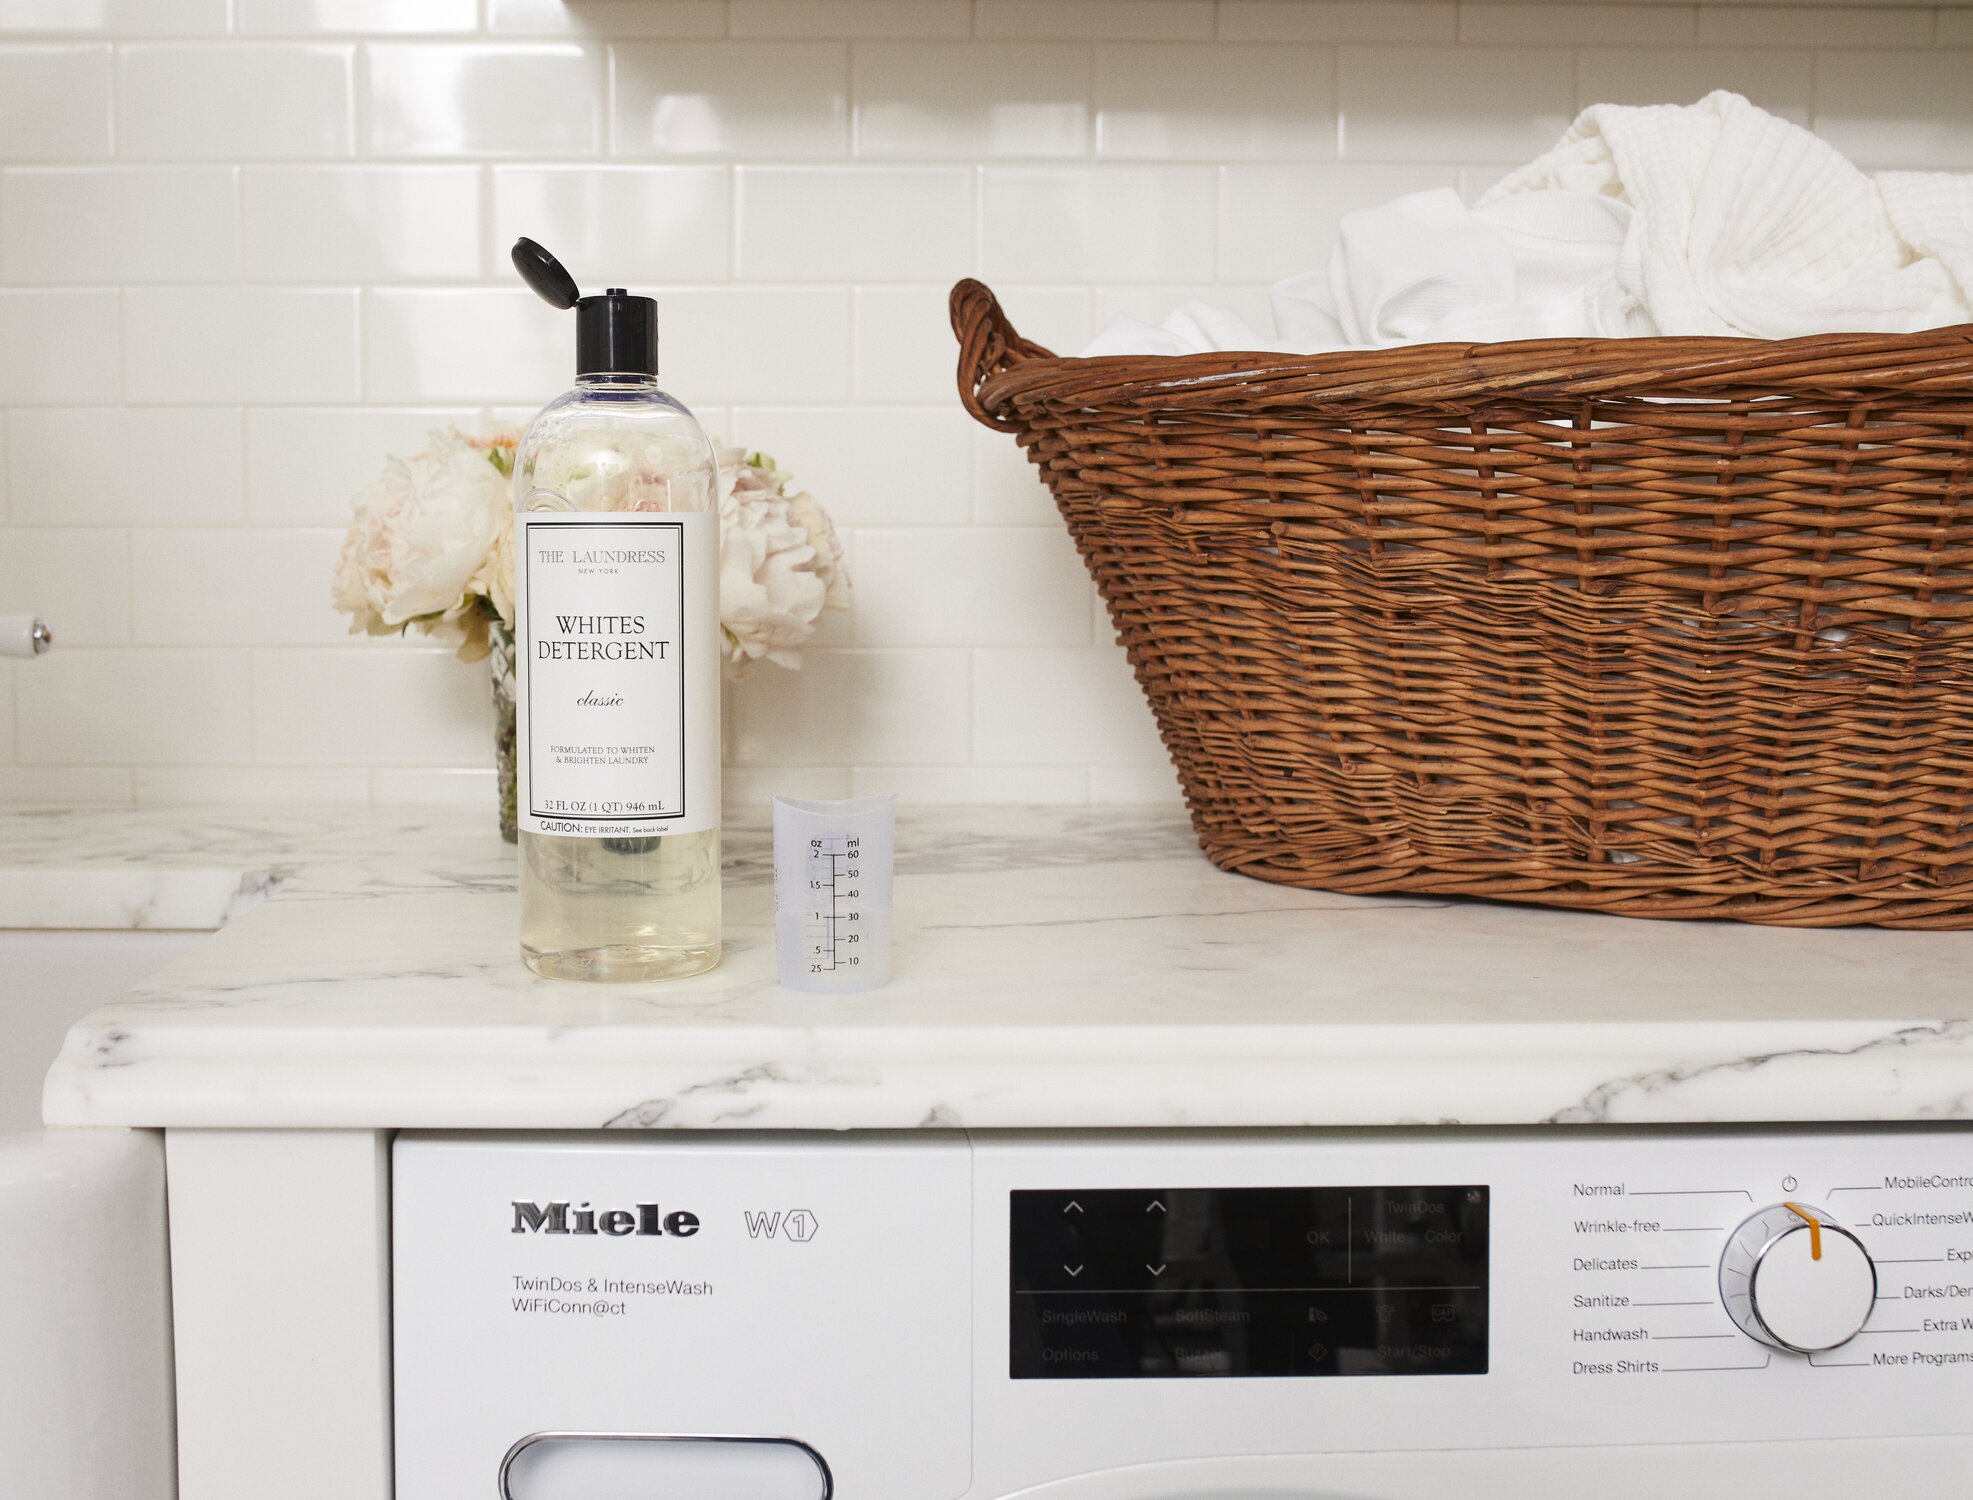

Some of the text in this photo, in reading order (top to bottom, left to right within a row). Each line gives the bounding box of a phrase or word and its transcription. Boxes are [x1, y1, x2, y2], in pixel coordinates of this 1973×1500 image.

[538, 550, 666, 564] THE LAUNDRESS
[556, 615, 645, 635] WHITES
[538, 640, 670, 661] DETERGENT
[576, 689, 625, 708] classic
[550, 745, 655, 755] FORMULATED TO WHITEN
[555, 756, 649, 765] & BRIGHTEN LAUNDRY
[544, 800, 665, 814] 32 FL OZ (1 QT) 946 mL
[540, 820, 583, 834] CAUTION:
[584, 826, 597, 834] EYE
[598, 826, 631, 834] IRRITANT.
[656, 825, 669, 833] label
[810, 839, 822, 848] oz
[847, 837, 860, 848] ml
[813, 849, 820, 859] 2
[847, 849, 859, 859] 60
[847, 869, 859, 879] 50
[809, 880, 821, 890] 1.5
[847, 889, 859, 899] 40
[815, 912, 820, 920] 1
[848, 912, 859, 921] 30
[848, 934, 859, 943] 20
[813, 945, 821, 954] .5
[848, 956, 859, 966] 10
[809, 964, 822, 973] .25
[1573, 1183, 1625, 1197] Normal
[1385, 1200, 1446, 1214] TwinDos
[511, 1199, 700, 1237] Miele
[1573, 1219, 1661, 1234] Wrinkle-free
[1306, 1231, 1330, 1244] OK
[1364, 1230, 1406, 1244] White
[1423, 1229, 1463, 1243] Color
[1947, 1248, 1973, 1264] Exp
[1573, 1257, 1639, 1272] Delicates
[512, 1276, 714, 1296] TwinDos & IntenseWash
[512, 1298, 627, 1317] WiFiConn@ct
[1573, 1294, 1630, 1308] Sanitize
[1041, 1310, 1127, 1326] SingleWash
[1175, 1308, 1250, 1322] SoftSteam
[1923, 1318, 1959, 1331] Extra
[1572, 1328, 1649, 1342] Handwash
[1042, 1348, 1099, 1363] Options
[1376, 1344, 1451, 1360] Start/Stop
[1872, 1352, 1909, 1366] More
[1572, 1360, 1660, 1375] Dress Shirts
